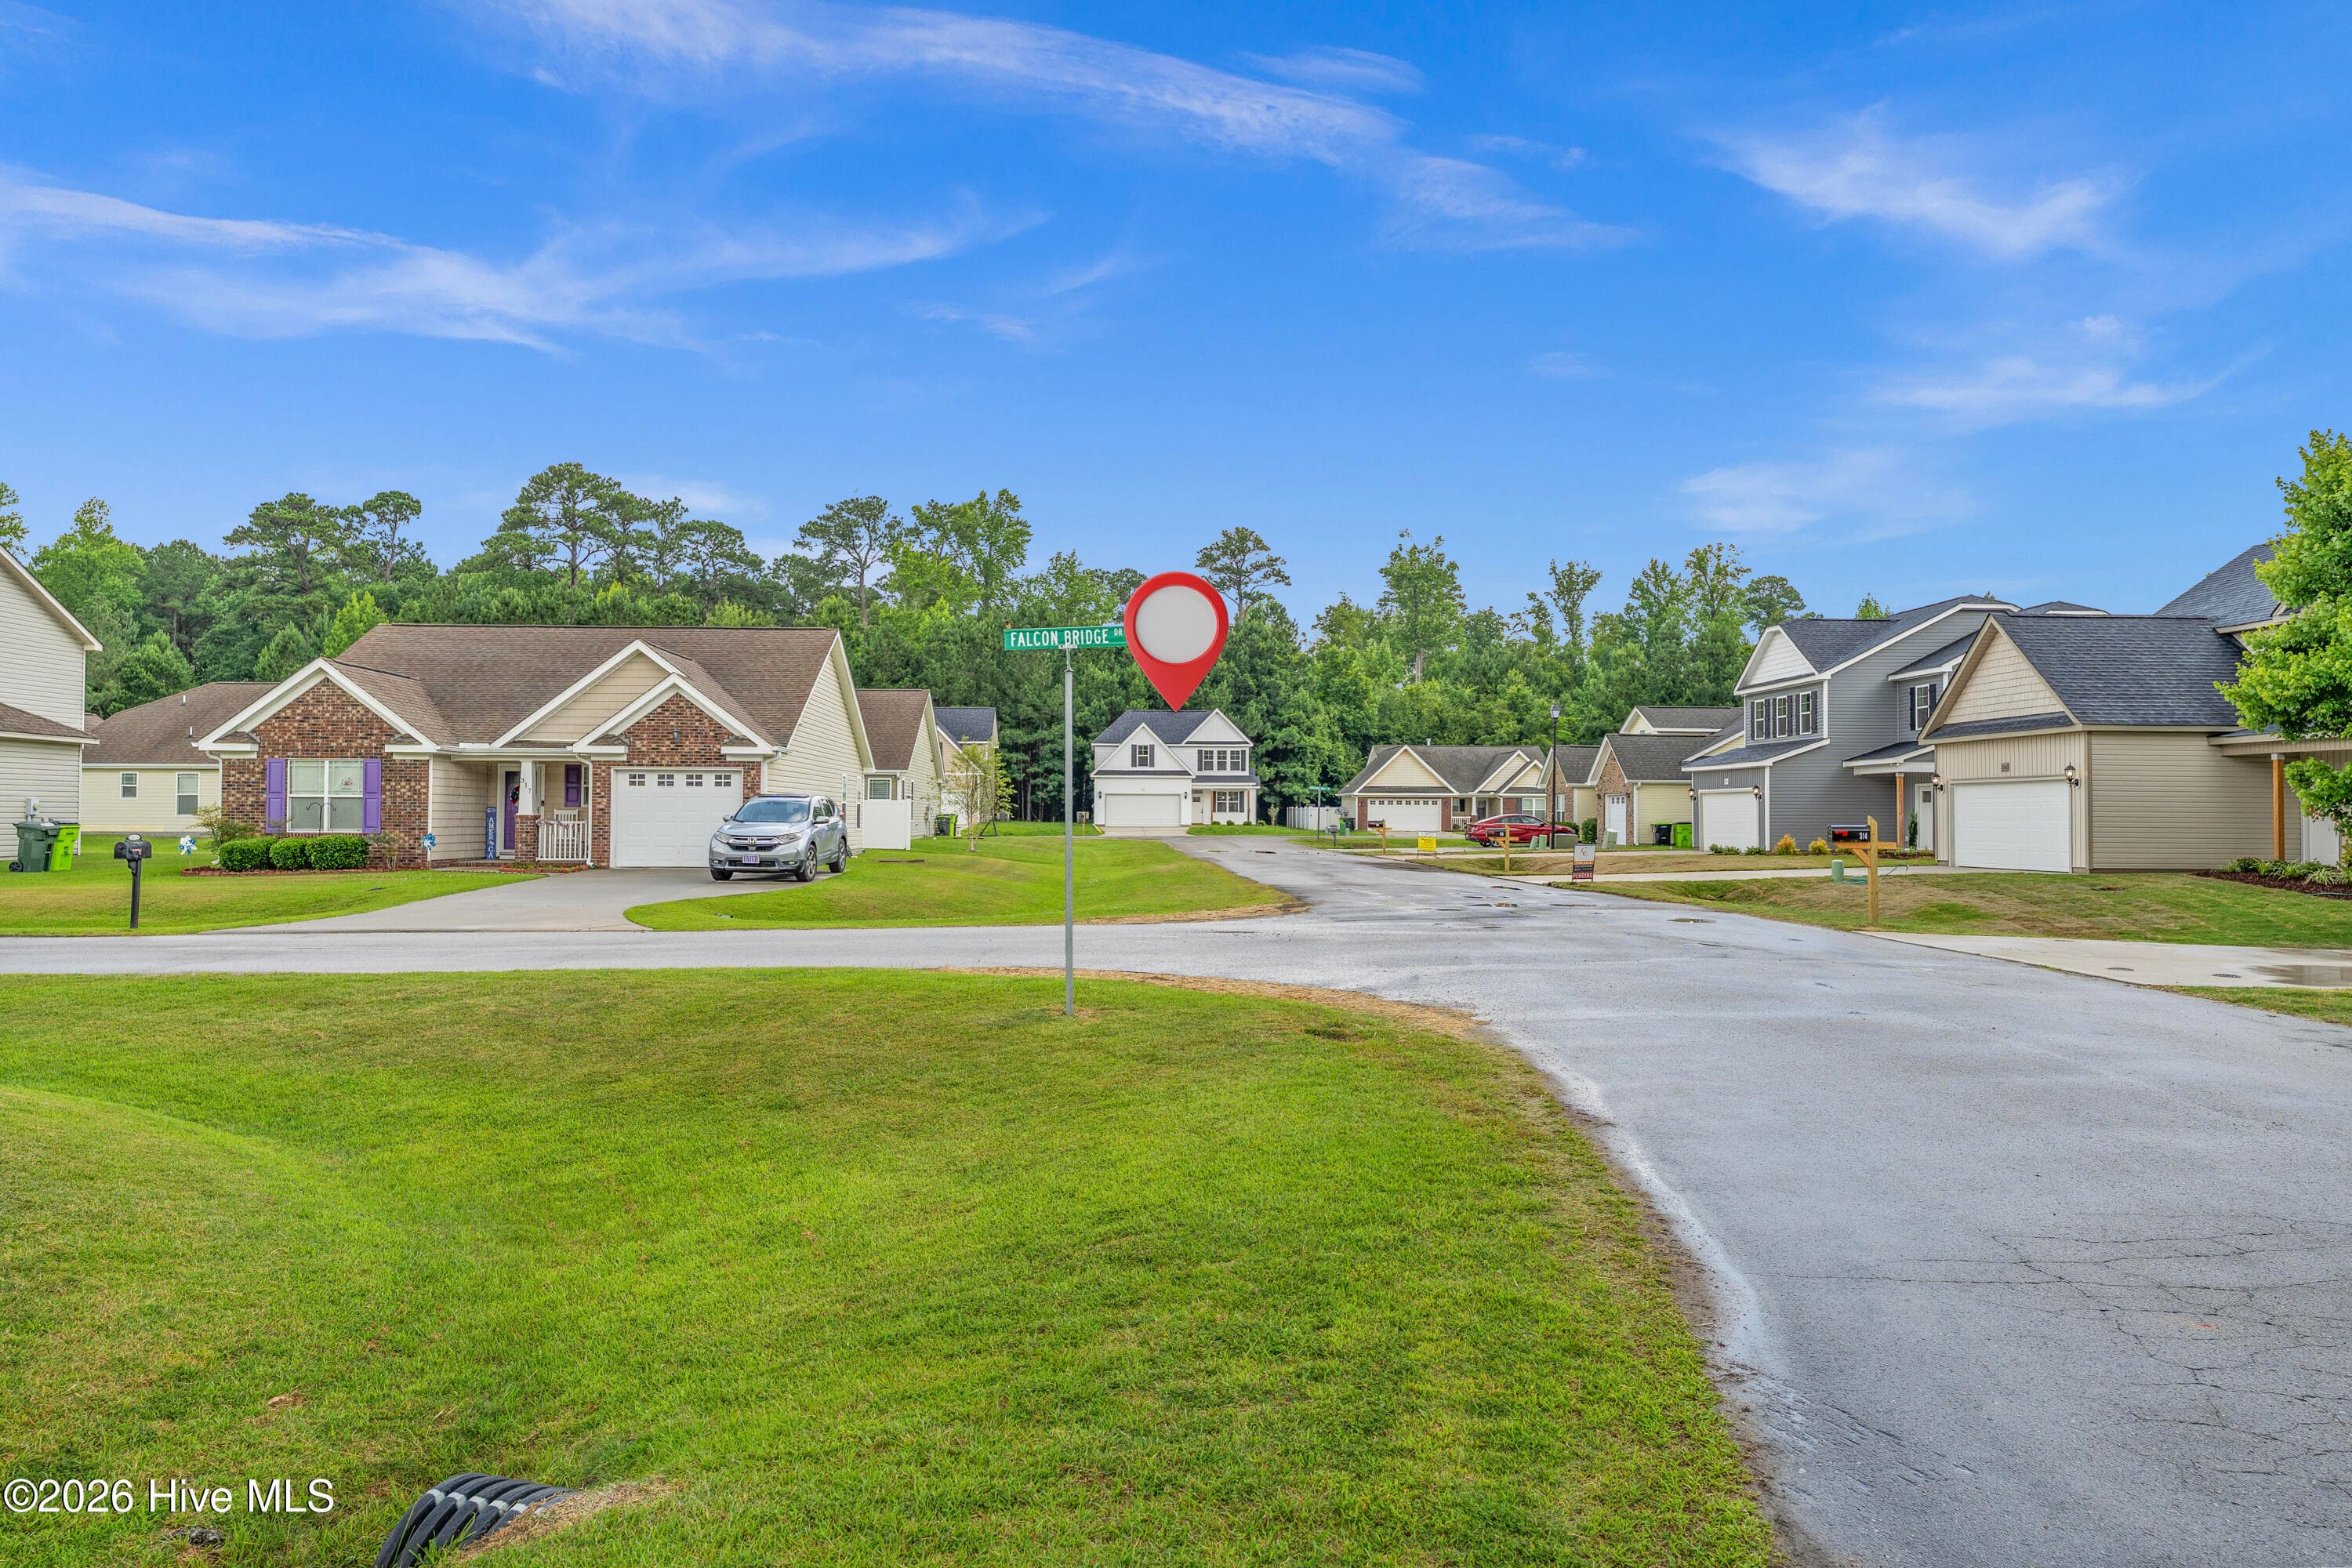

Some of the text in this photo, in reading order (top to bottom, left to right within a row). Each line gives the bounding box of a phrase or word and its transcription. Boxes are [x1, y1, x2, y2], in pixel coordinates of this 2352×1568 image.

[1011, 627, 1123, 647] FALCON BRIDGE DR
[521, 777, 532, 794] 317
